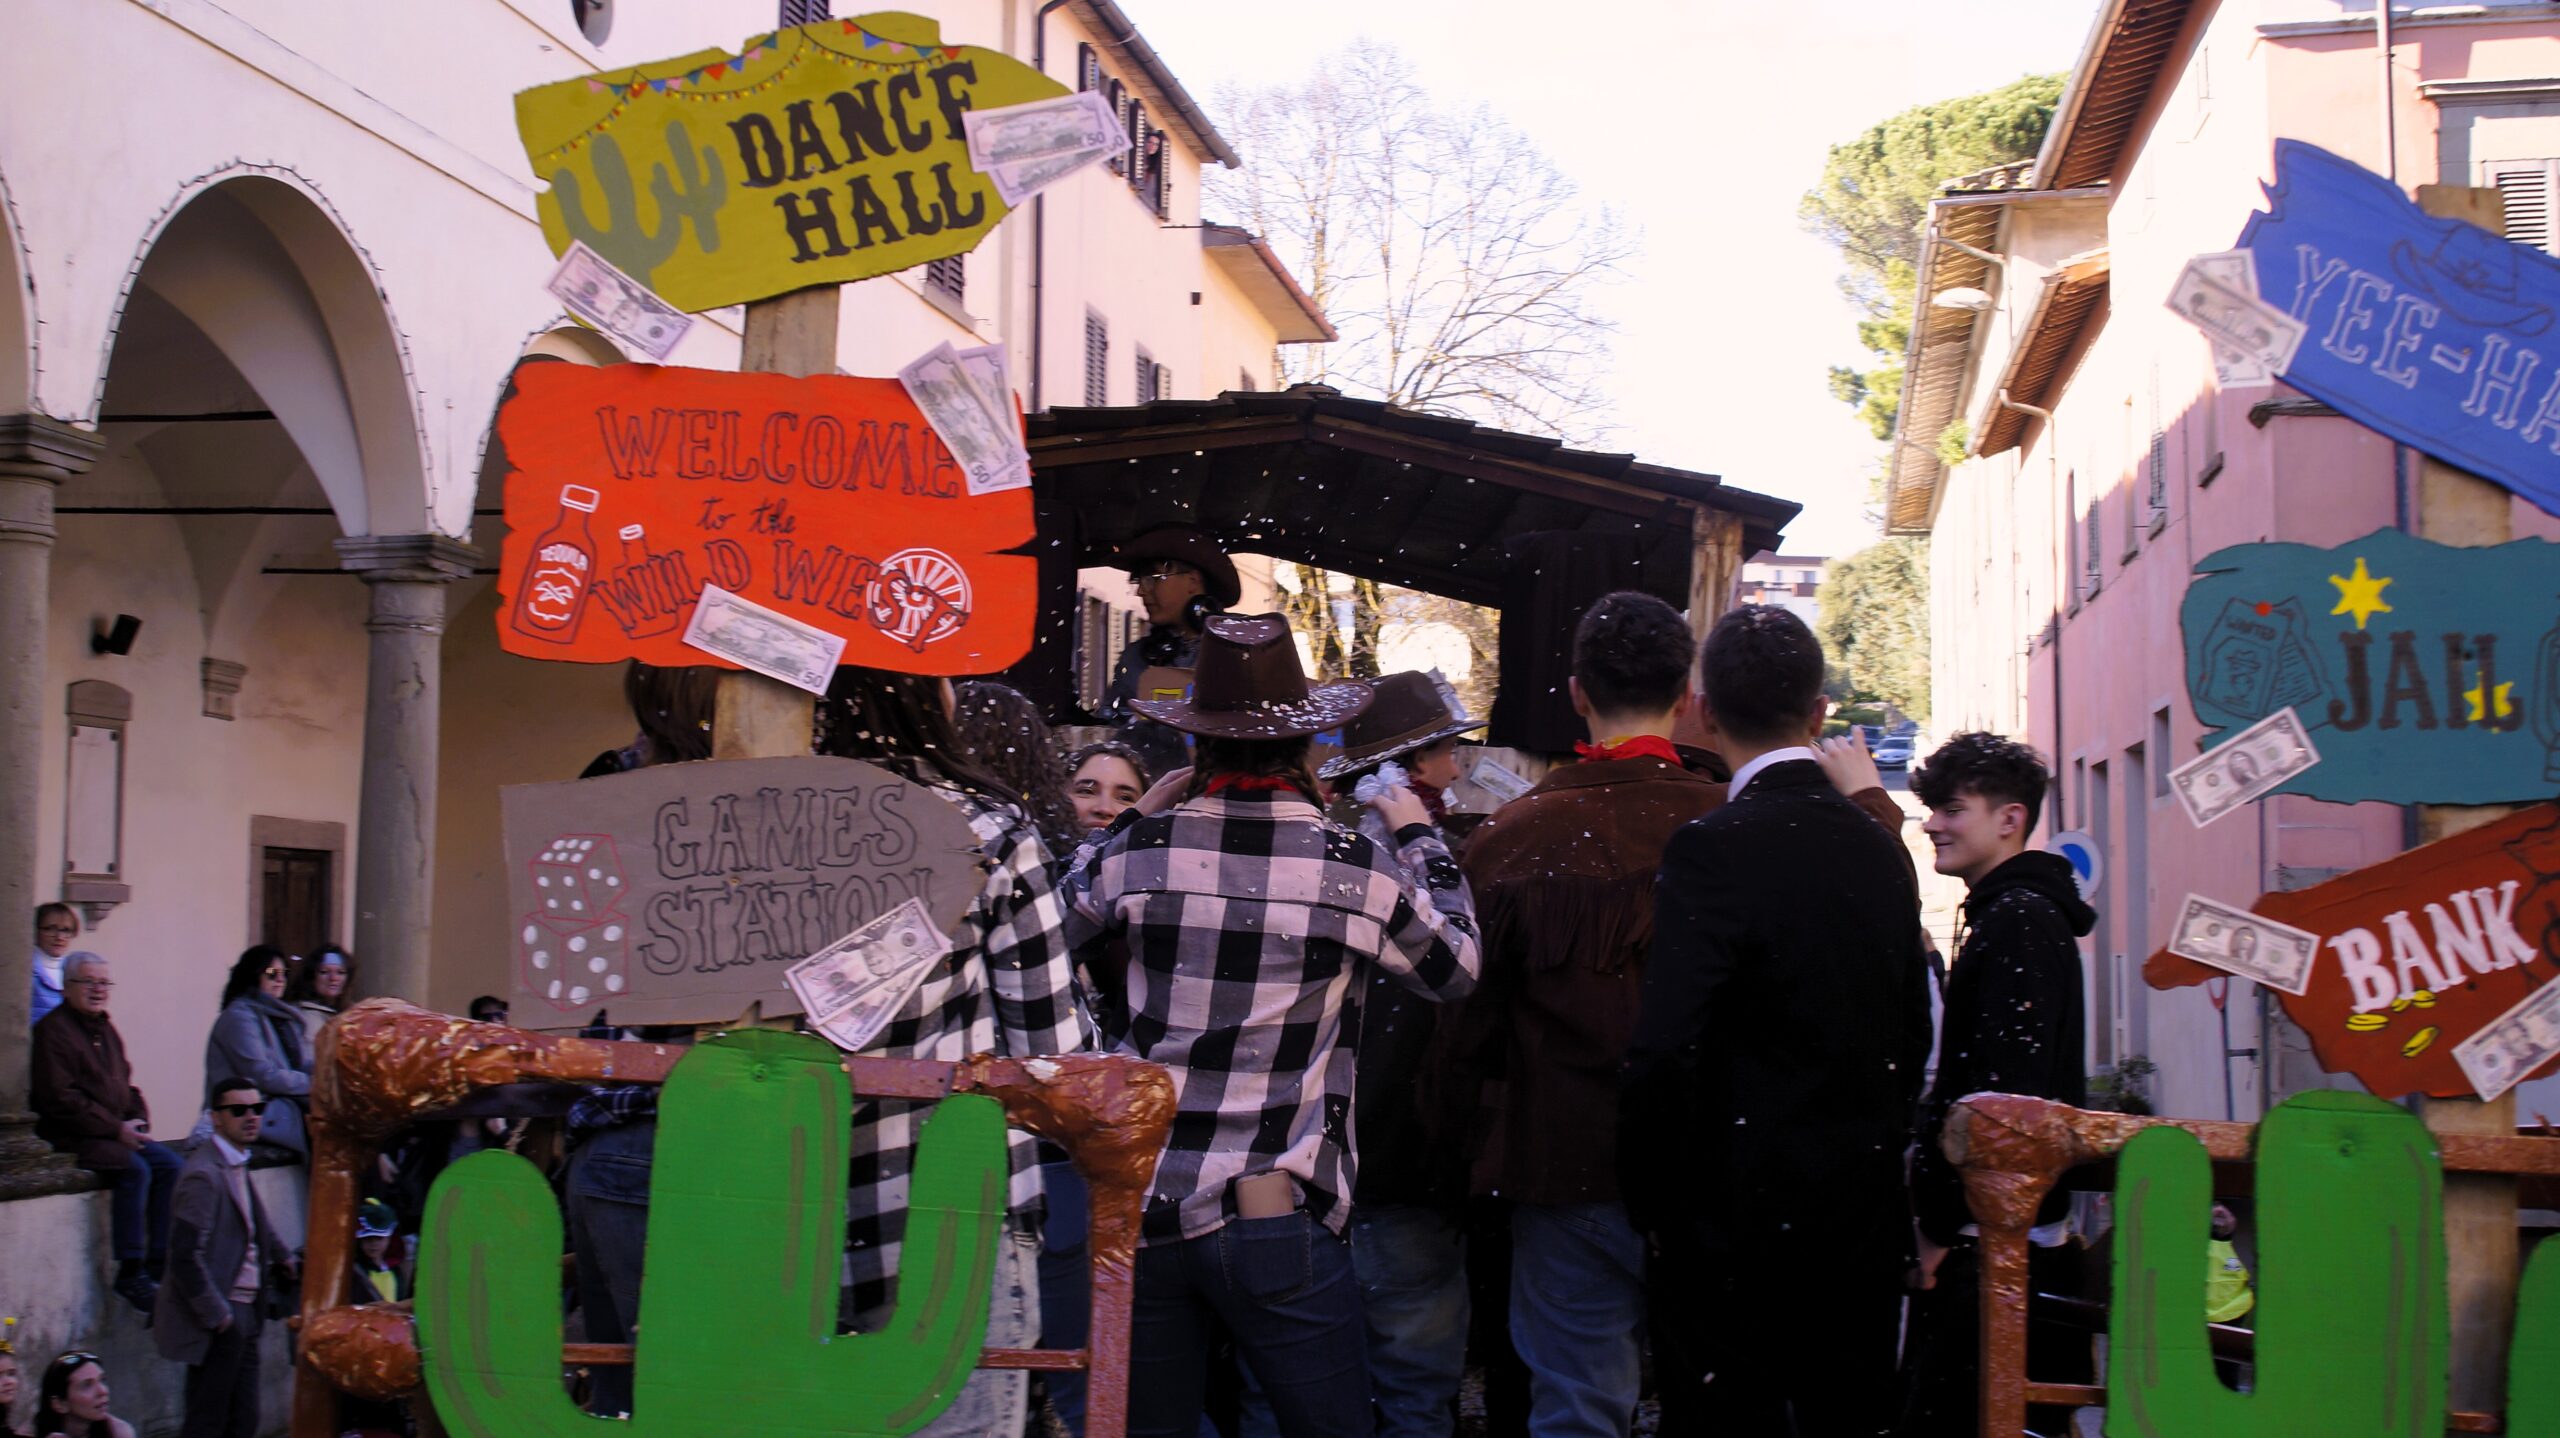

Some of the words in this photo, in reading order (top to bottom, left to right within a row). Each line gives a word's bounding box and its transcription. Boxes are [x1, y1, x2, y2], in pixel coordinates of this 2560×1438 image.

[726, 60, 977, 188] DANCE
[774, 162, 986, 263] HALL
[596, 405, 960, 498] WELCOME
[697, 498, 736, 531] to
[749, 498, 797, 534] the
[588, 538, 752, 633] WILD
[773, 540, 971, 653] WEST
[803, 671, 824, 689] 50
[2328, 630, 2525, 732] JAIL
[653, 784, 918, 880] GAMES
[2326, 880, 2538, 1014] BANK
